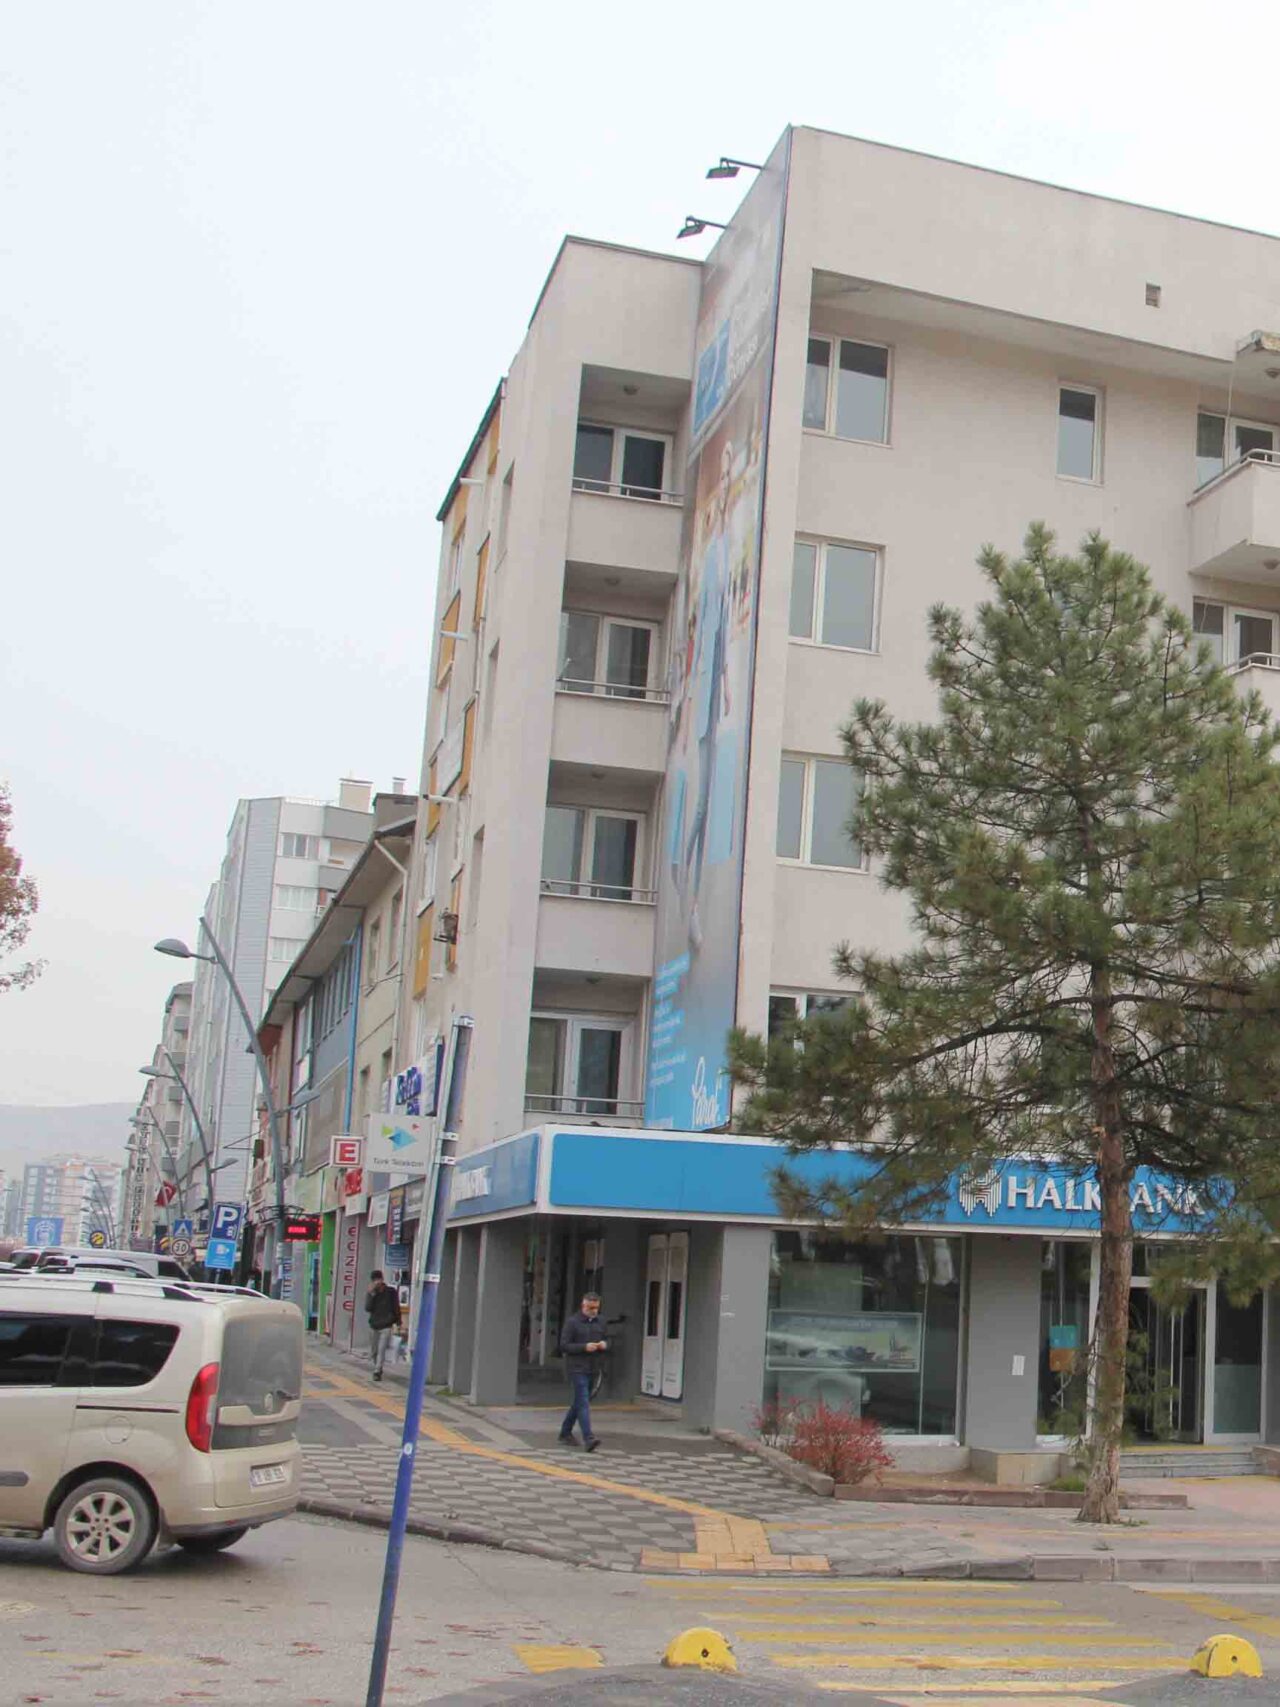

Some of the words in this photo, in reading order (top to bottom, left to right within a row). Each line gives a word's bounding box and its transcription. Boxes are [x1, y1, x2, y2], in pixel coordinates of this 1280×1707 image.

[339, 1143, 356, 1162] E
[1007, 1175, 1206, 1216] HALKANK
[216, 1206, 239, 1229] P
